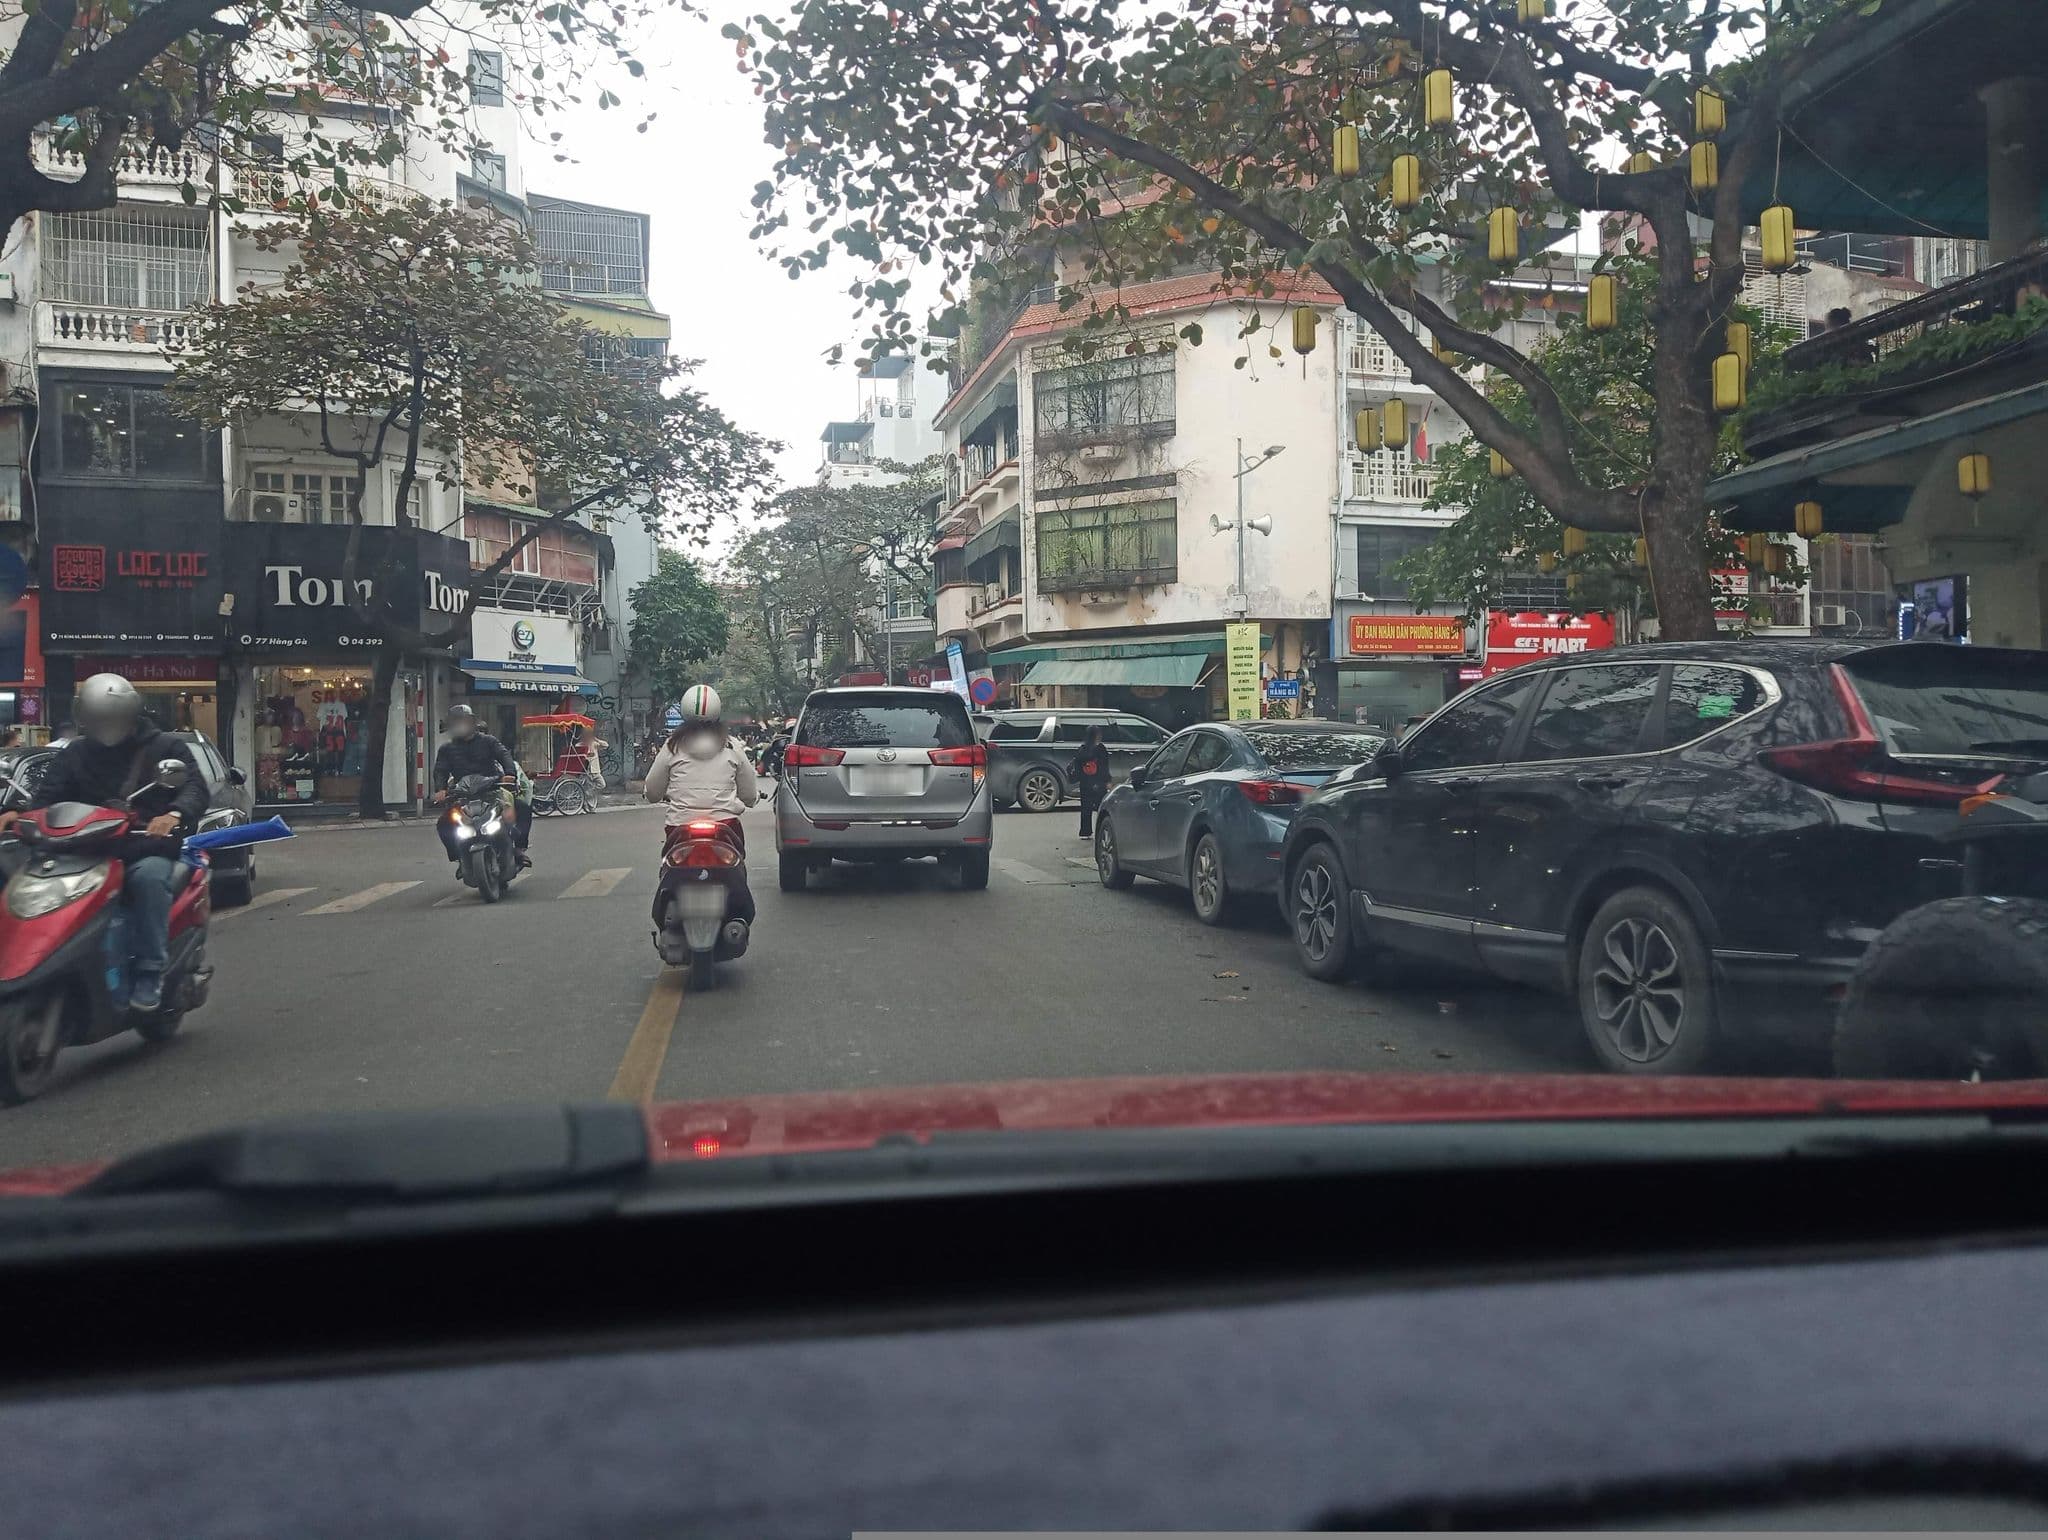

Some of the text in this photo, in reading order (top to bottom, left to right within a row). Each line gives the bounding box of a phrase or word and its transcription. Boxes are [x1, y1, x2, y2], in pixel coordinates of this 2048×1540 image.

[1365, 625, 1377, 639] BAN
[1378, 623, 1395, 639] NHÂN
[1396, 622, 1409, 639] DÂN
[255, 637, 268, 645] 77
[269, 637, 292, 646] Hàng
[540, 684, 559, 692] CAO
